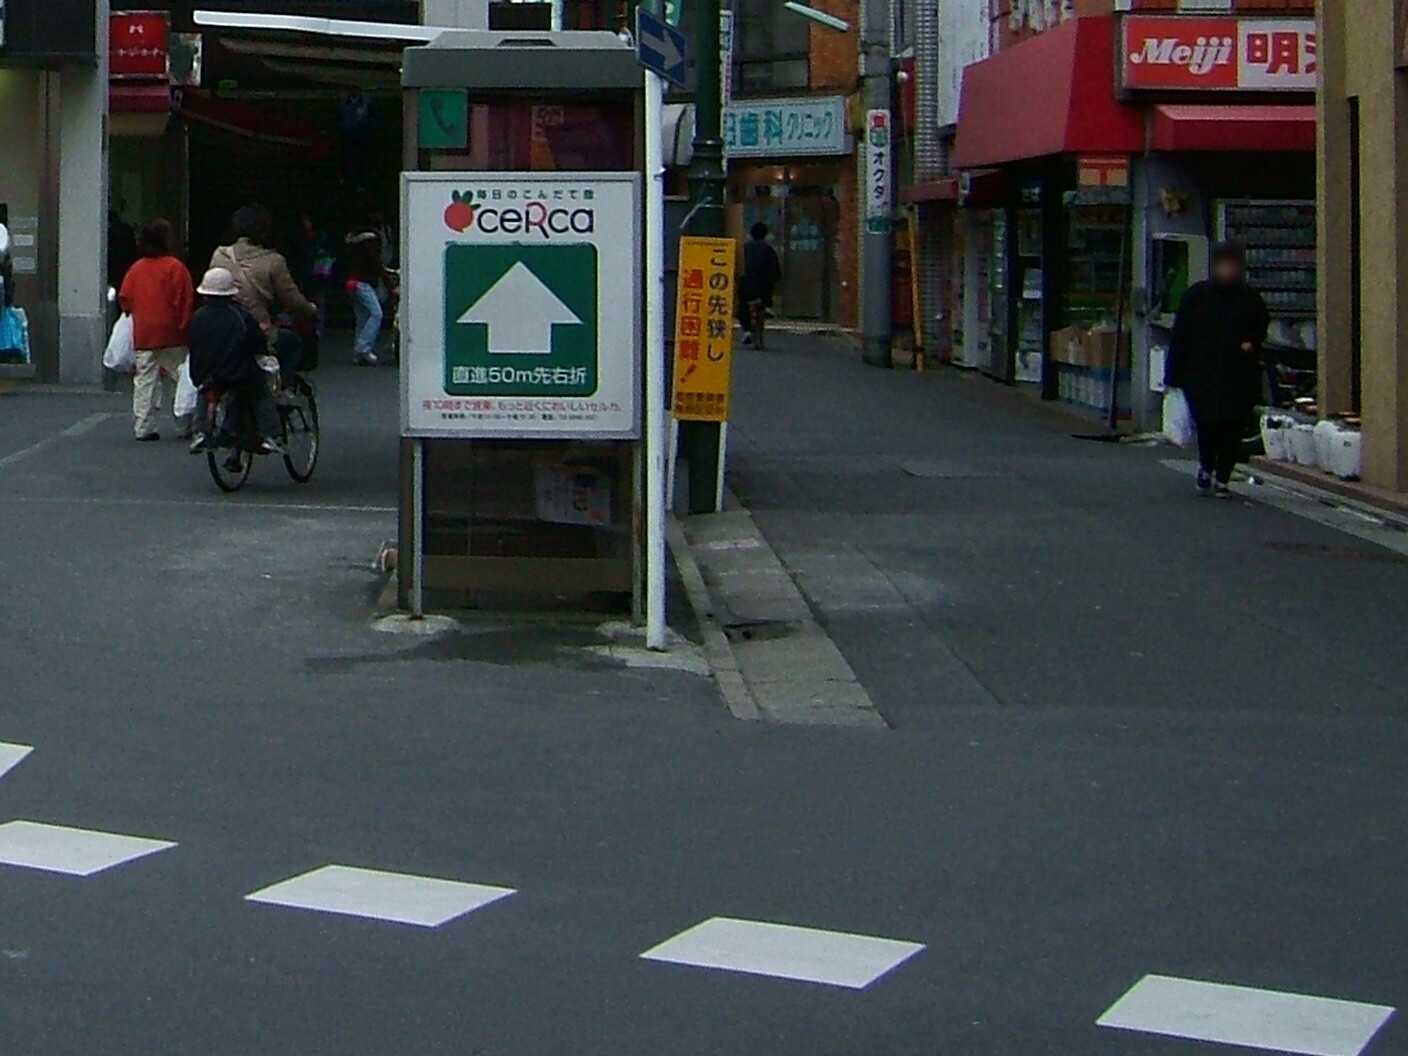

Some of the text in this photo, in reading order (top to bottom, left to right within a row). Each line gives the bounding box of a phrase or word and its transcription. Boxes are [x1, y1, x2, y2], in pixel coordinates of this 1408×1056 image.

[1129, 36, 1232, 75] Meiji
[707, 248, 729, 362] この先狭し
[452, 366, 587, 385] 直進50m先右折
